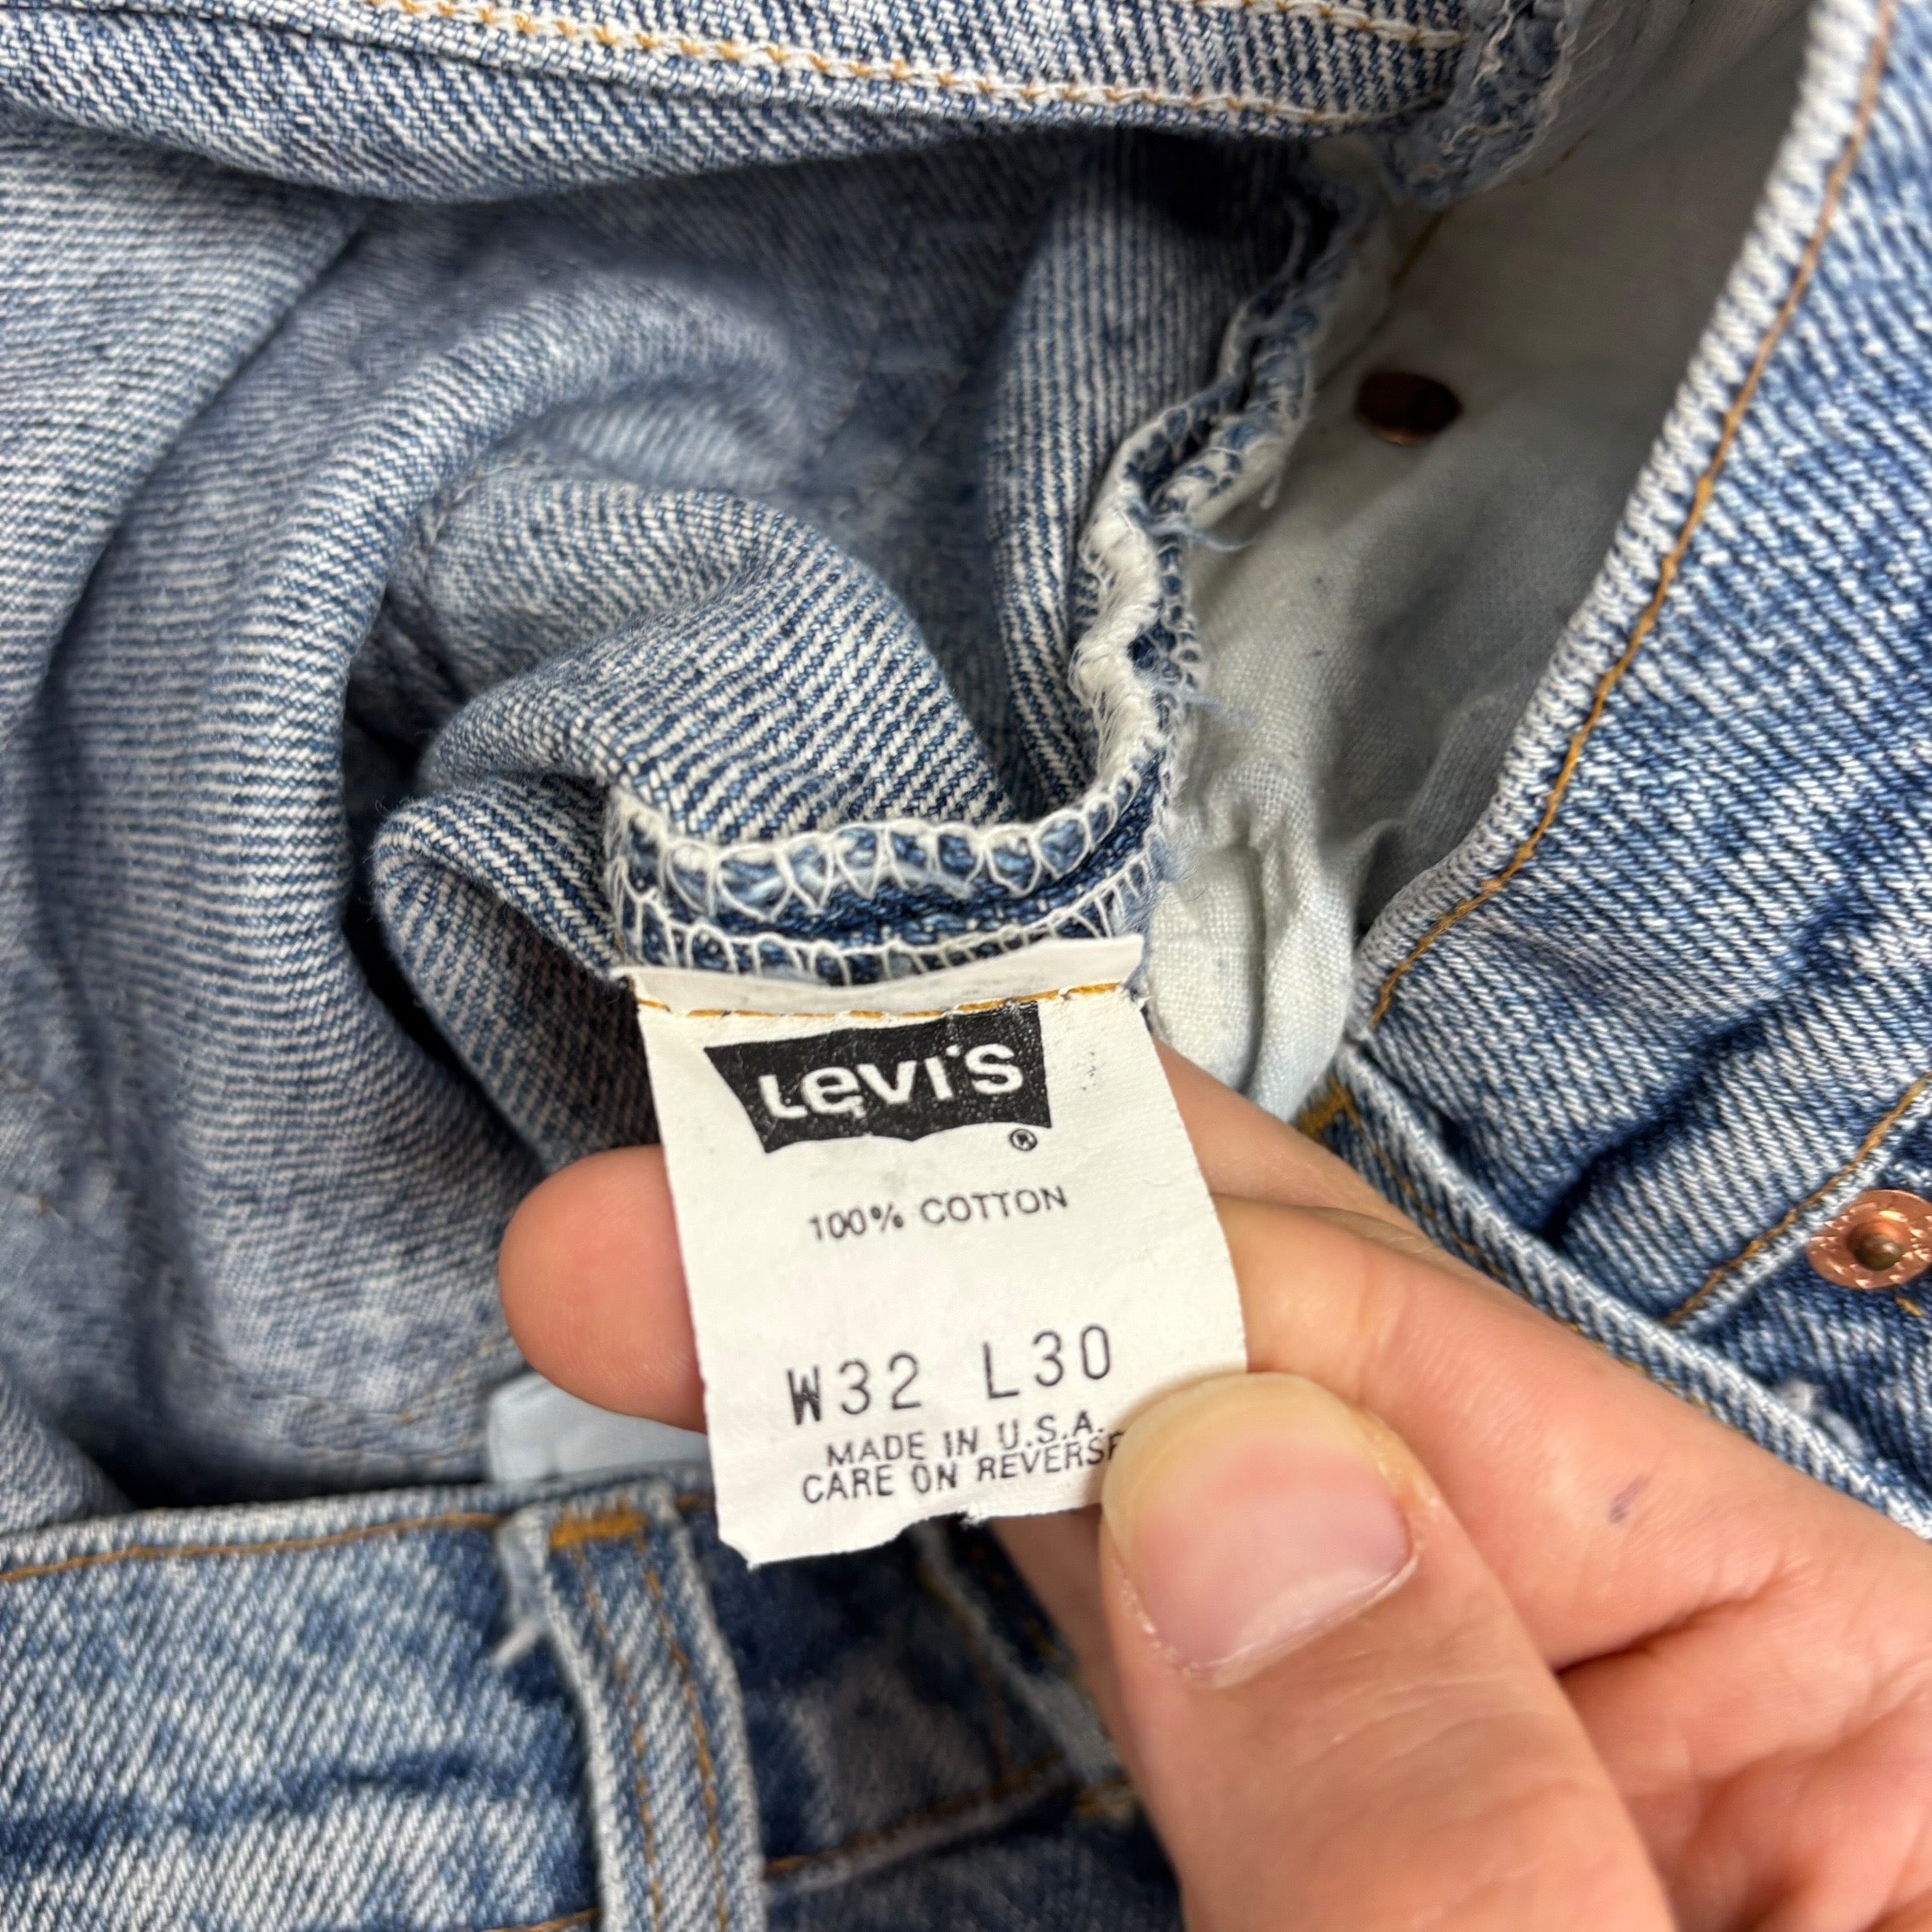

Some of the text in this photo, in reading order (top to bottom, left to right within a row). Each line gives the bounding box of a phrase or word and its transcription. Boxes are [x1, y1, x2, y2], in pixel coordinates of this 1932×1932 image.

[809, 1186, 1067, 1240] 100% COTTON
[787, 1324, 1111, 1426] W32 L30
[827, 1410, 1104, 1467] MADE IN U.S.A.
[803, 1463, 894, 1504] CARE
[911, 1461, 958, 1494] ON
